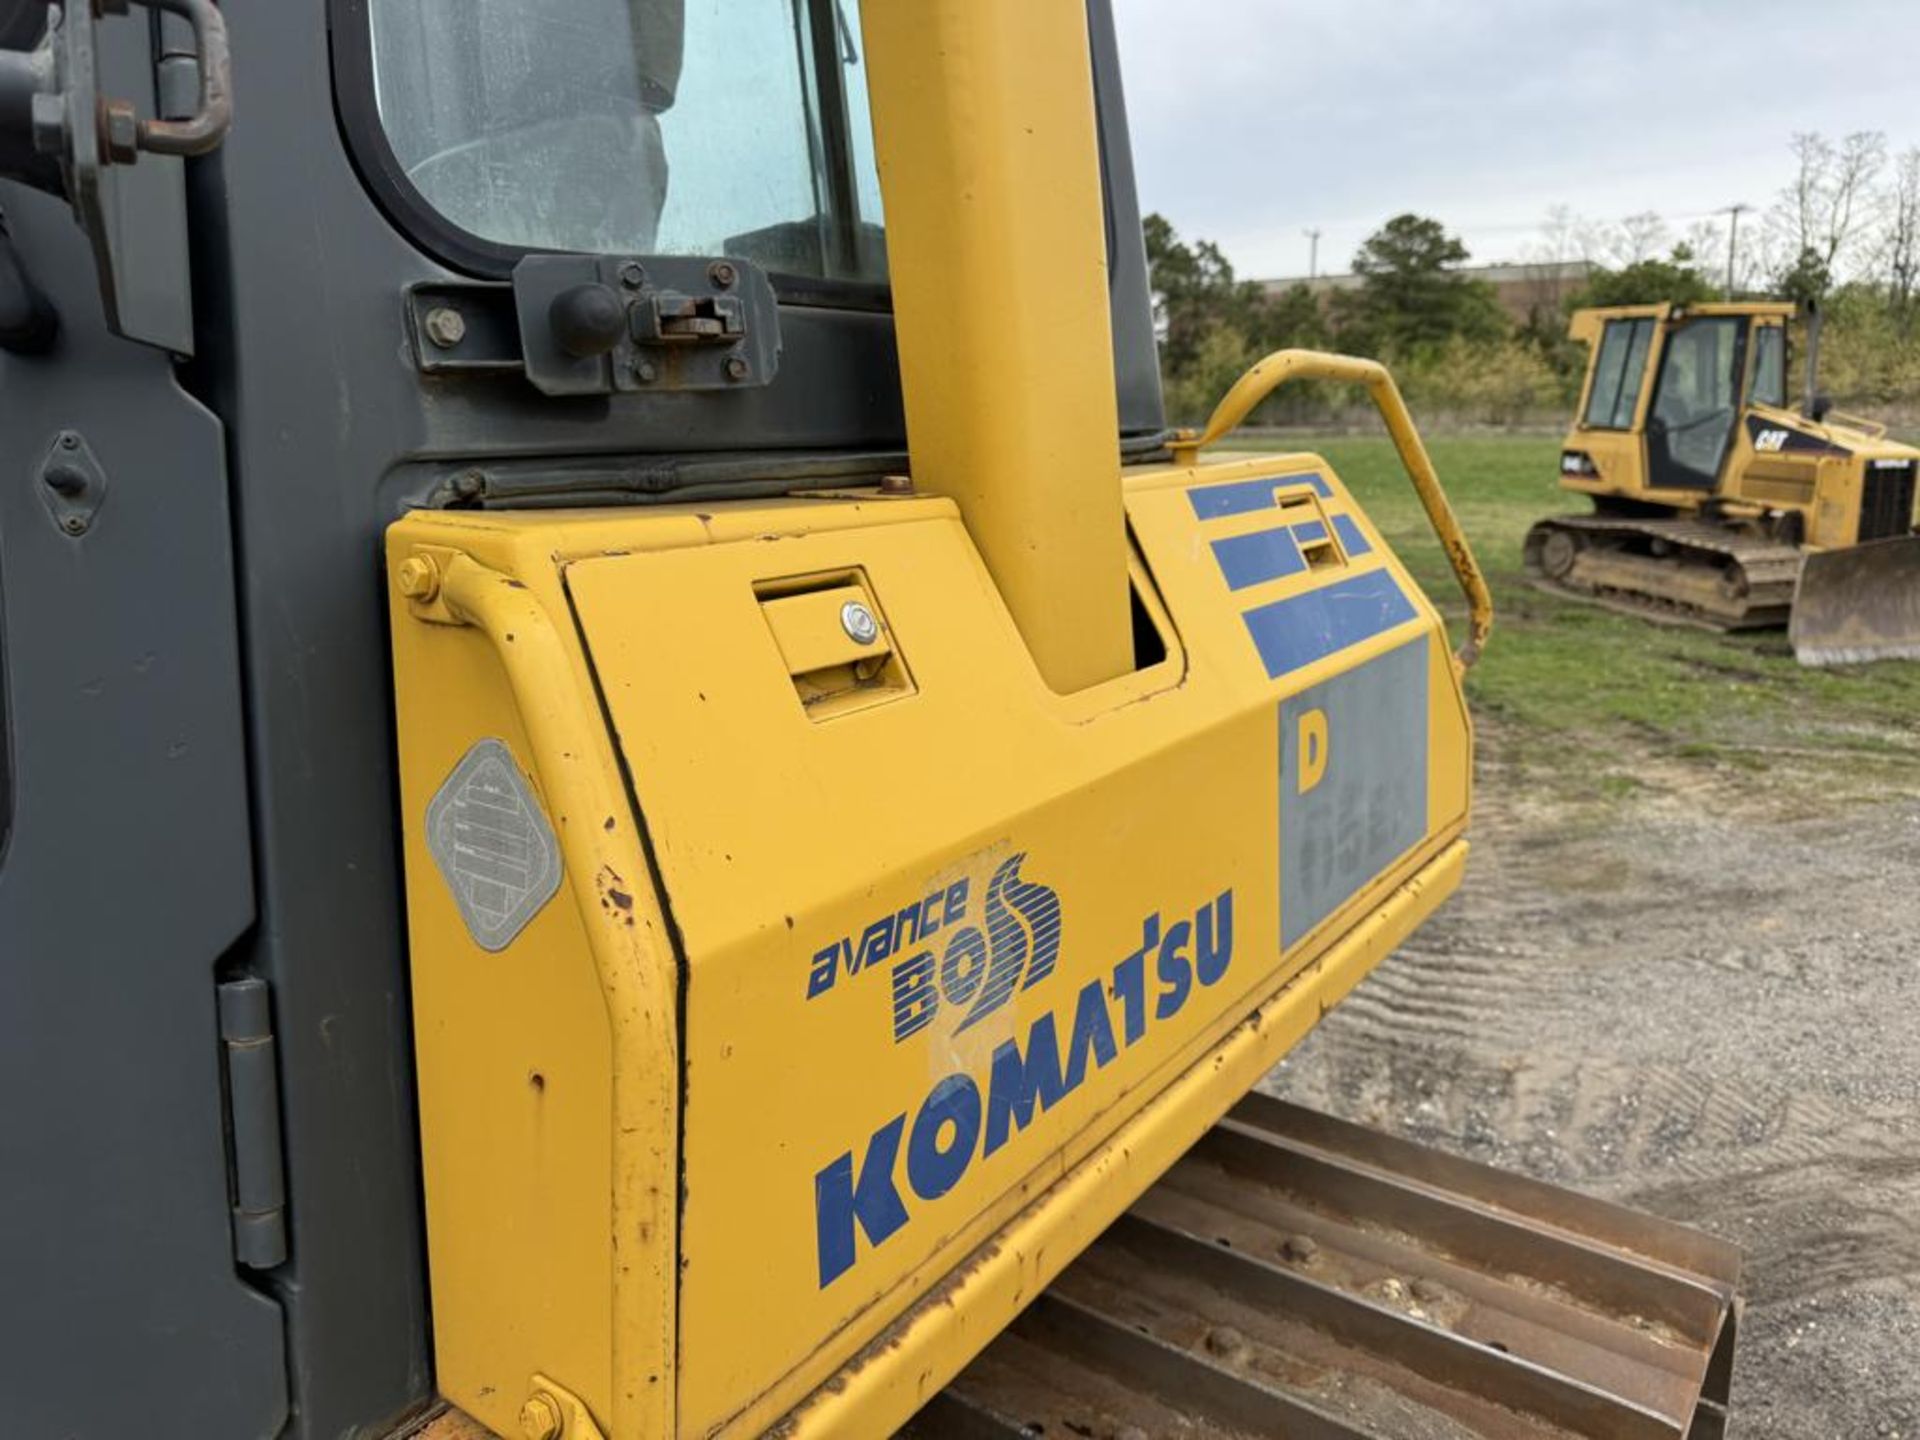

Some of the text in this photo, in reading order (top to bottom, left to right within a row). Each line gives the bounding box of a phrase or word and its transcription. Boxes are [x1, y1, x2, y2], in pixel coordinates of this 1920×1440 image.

[1754, 429, 1789, 451] CAT
[1298, 708, 1328, 795] D
[806, 876, 969, 1001] avance
[892, 852, 1061, 1044] BOSS
[815, 888, 1234, 1290] KOMATSU
